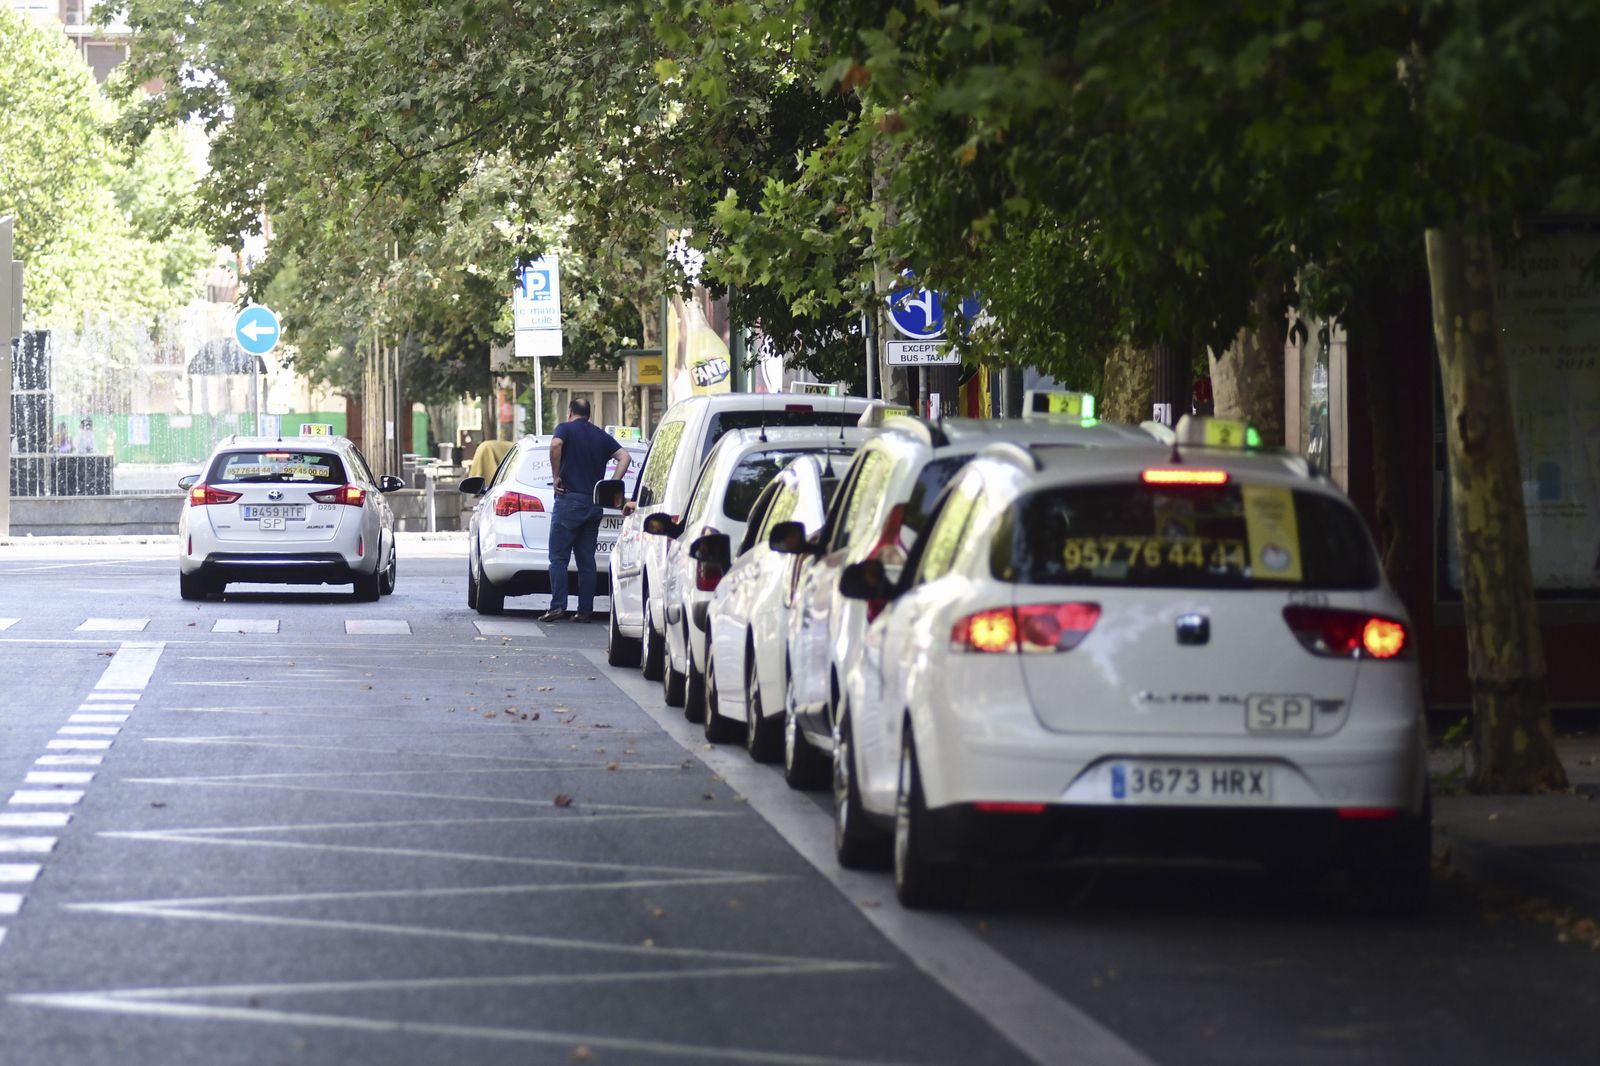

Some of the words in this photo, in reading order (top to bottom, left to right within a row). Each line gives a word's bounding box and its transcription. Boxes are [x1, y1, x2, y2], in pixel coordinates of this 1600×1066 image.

[520, 307, 555, 315] cmino
[691, 357, 730, 386] FANTA
[308, 467, 317, 475] 00
[252, 507, 282, 517] 8459
[282, 507, 304, 517] HTF
[263, 519, 282, 529] SP
[1064, 539, 1118, 572] 957
[1125, 539, 1162, 568] 76
[1167, 539, 1204, 569] 44
[1256, 699, 1302, 728] SP
[1131, 768, 1200, 795] 3673
[1211, 769, 1264, 795] HRX
